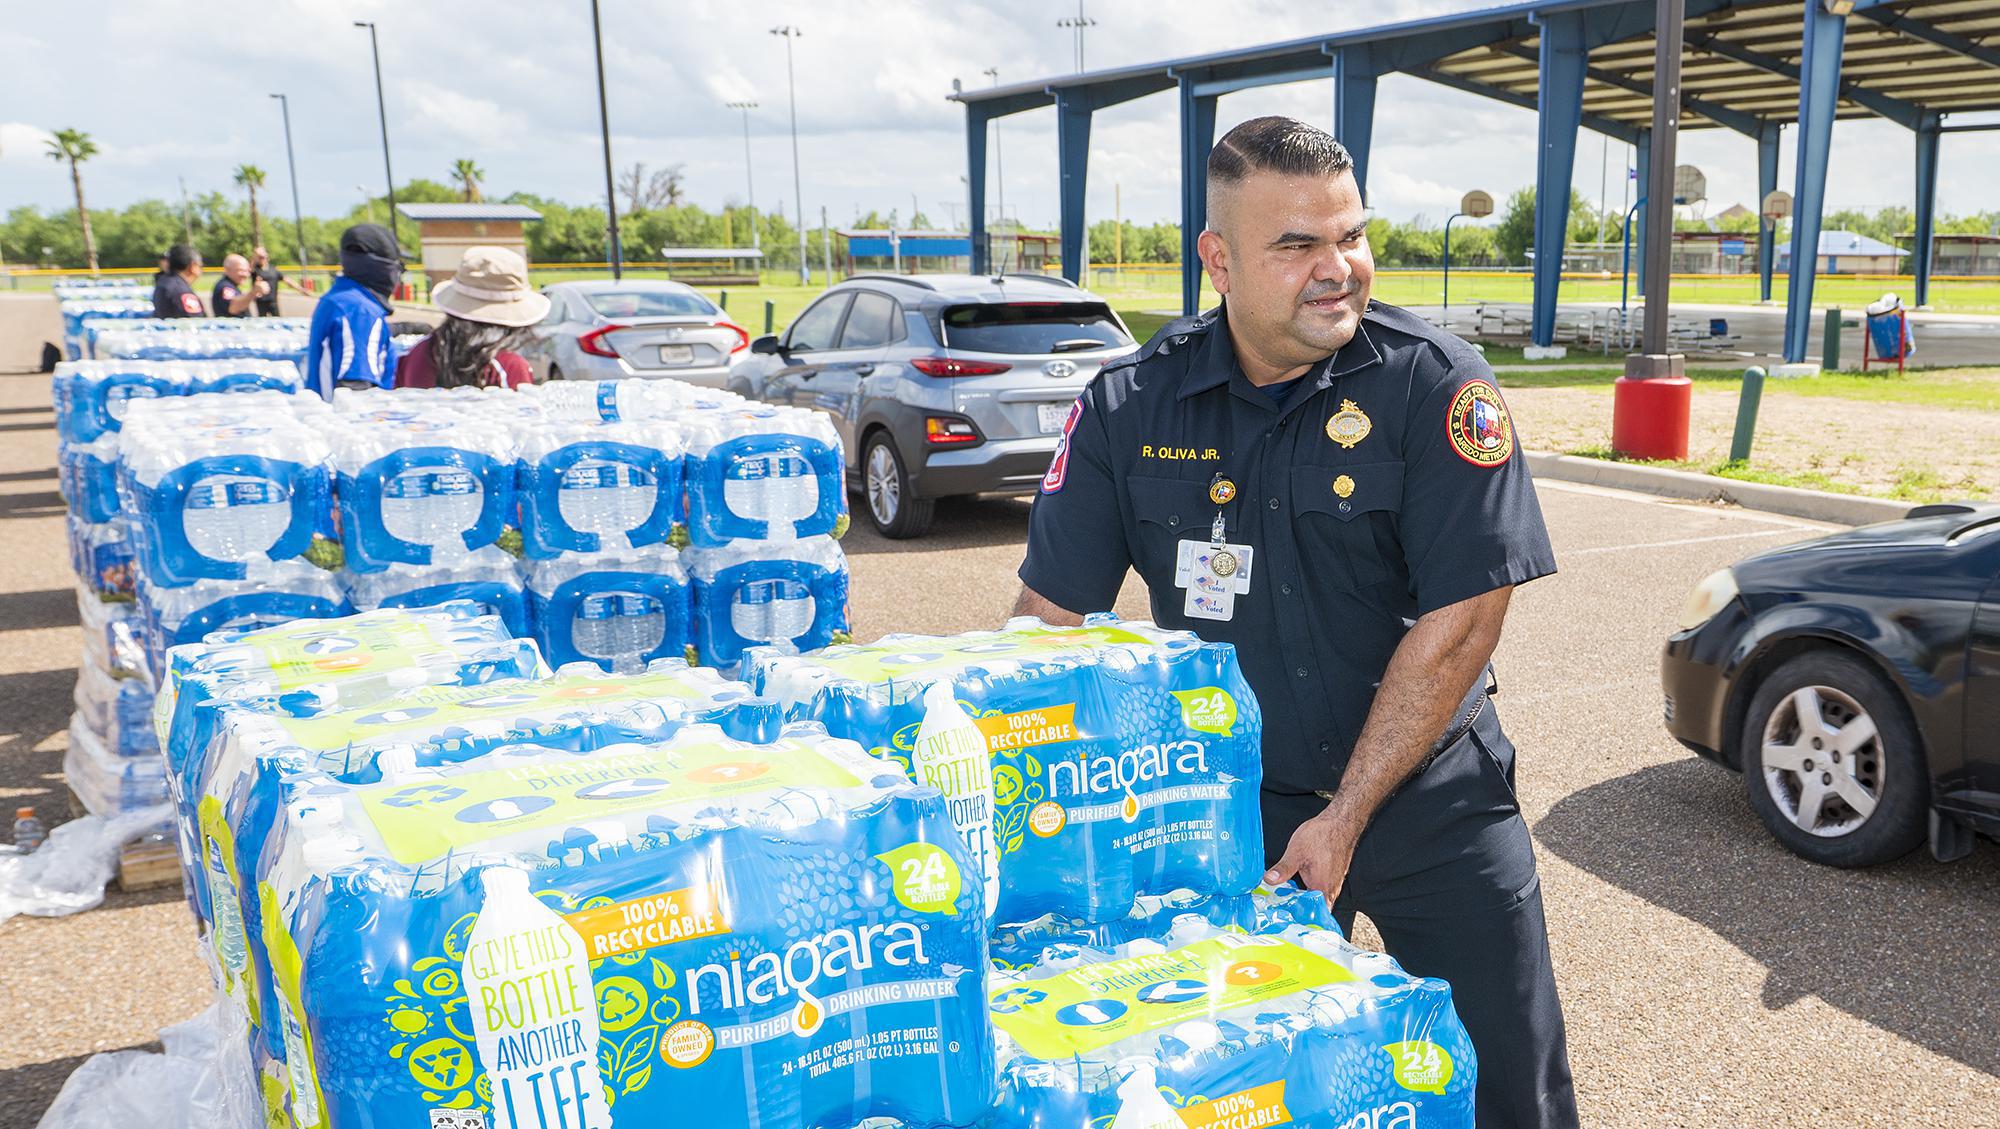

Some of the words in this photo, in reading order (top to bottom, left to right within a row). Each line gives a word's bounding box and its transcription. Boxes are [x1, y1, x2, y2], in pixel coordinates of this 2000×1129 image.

[1454, 389, 1472, 417] READY
[1472, 386, 1485, 395] FOR
[1142, 445, 1155, 458] R.
[1158, 447, 1197, 460] OLIVA
[1201, 448, 1220, 460] JR.
[1454, 432, 1480, 457] LAREDO
[1479, 449, 1503, 461] METRO
[1208, 585, 1226, 593] Voted
[1206, 606, 1224, 614] Voted
[1190, 692, 1226, 714] 24
[1007, 711, 1047, 730] 100%
[918, 730, 951, 762] GIVE
[990, 724, 1070, 749] RECYCLABLE
[527, 759, 686, 791] DIFFERENCE
[924, 754, 988, 798] BOTTLE
[1048, 740, 1209, 823] niagara
[1070, 804, 1120, 822] PURIFIED
[1142, 788, 1188, 806] DRINKING
[1190, 785, 1227, 798] WATER
[1112, 839, 1121, 849] 24
[1167, 822, 1179, 833] 1.05
[1179, 821, 1187, 831] PT
[1187, 820, 1214, 829] BOTTLES
[1201, 830, 1214, 840] GAL
[901, 852, 946, 886] 24
[621, 896, 679, 926] 100%
[911, 891, 947, 904] BOTTLES
[593, 911, 716, 956] RECYCLABLE
[469, 935, 525, 980] GIVE
[521, 923, 572, 966] THIS
[685, 921, 930, 1038] niagara
[1090, 959, 1207, 993] DIFFERENCE
[480, 964, 585, 1032] BOTTLE
[721, 1015, 789, 1048] PURIFIED
[829, 981, 902, 1014] DRINKING
[904, 979, 954, 998] WATER
[497, 1019, 587, 1072] ANOTHER
[672, 1031, 701, 1045] FAMILY
[672, 1041, 703, 1054] OWNED
[781, 1062, 793, 1076] 24
[797, 1052, 812, 1069] 16.9
[813, 1049, 822, 1062] FL
[822, 1045, 833, 1058] OZ
[833, 1039, 853, 1056] (500
[854, 1034, 870, 1048] mL)
[872, 1031, 890, 1044] 1.05
[891, 1030, 901, 1042] PT
[903, 1027, 939, 1041] BOTTLES
[808, 1062, 831, 1079] TOTAL
[831, 1052, 854, 1069] 405.6
[855, 1050, 865, 1062] FL
[866, 1047, 877, 1060] OZ
[878, 1045, 892, 1060] (12
[893, 1043, 903, 1057] L)
[905, 1042, 921, 1055] 3.16
[923, 1041, 940, 1054] GAL
[1402, 1049, 1442, 1071] 24
[1403, 1071, 1443, 1079] RECYCLABLE
[1212, 1093, 1255, 1118] 100%
